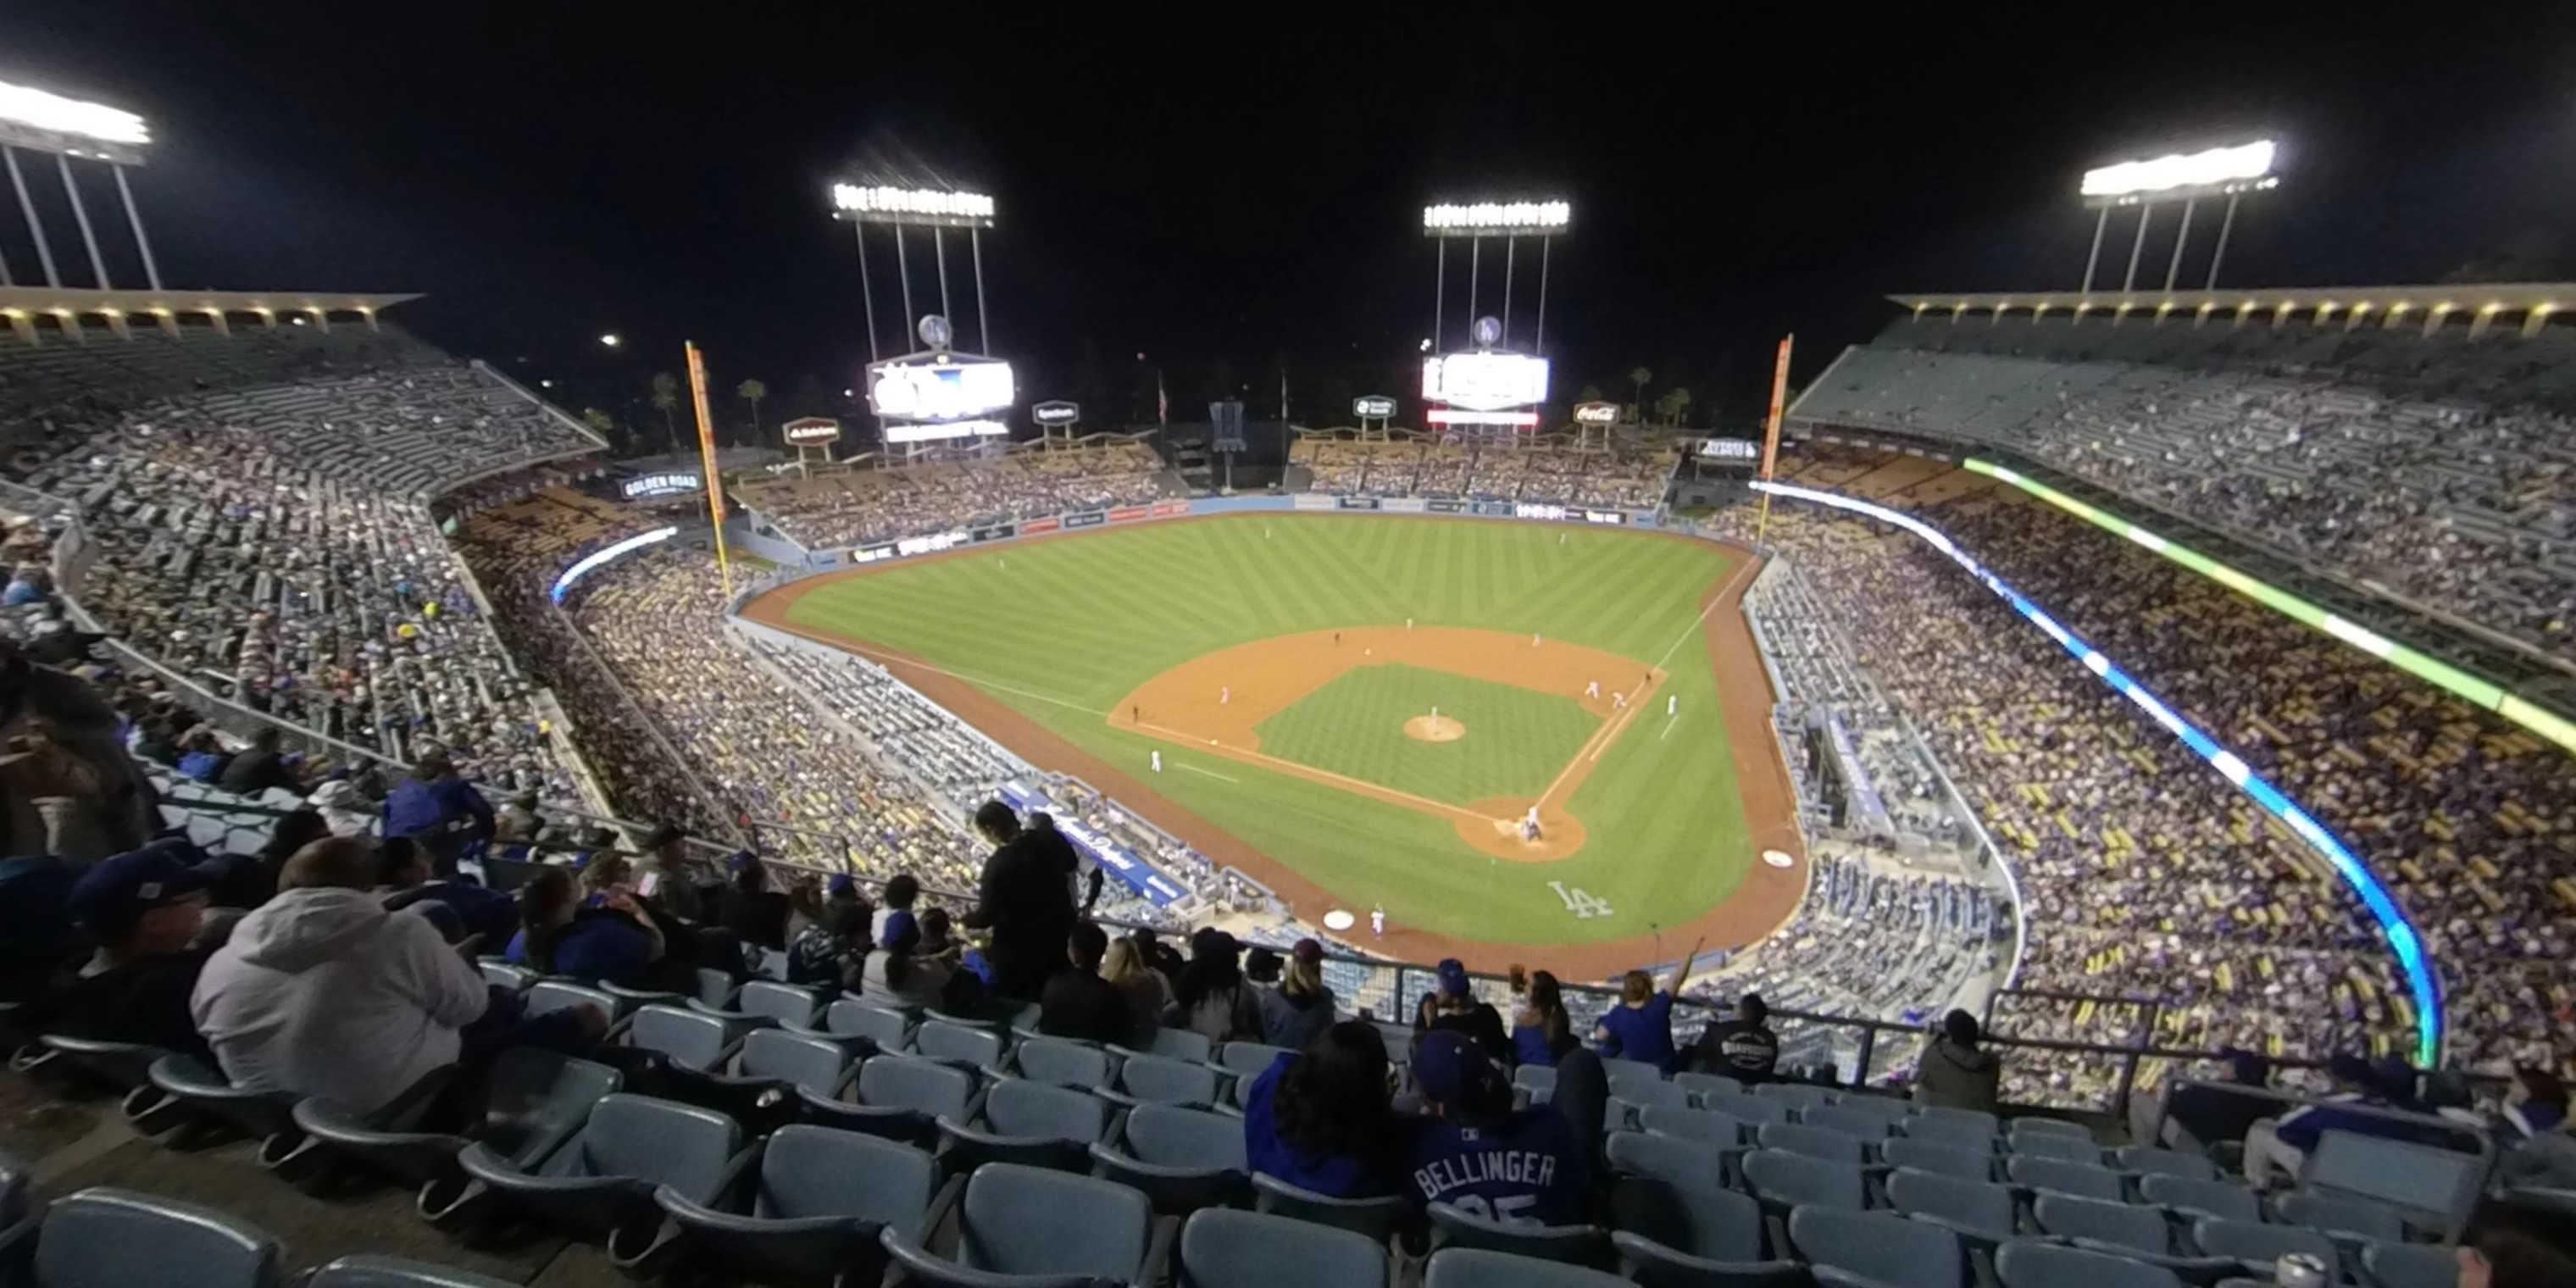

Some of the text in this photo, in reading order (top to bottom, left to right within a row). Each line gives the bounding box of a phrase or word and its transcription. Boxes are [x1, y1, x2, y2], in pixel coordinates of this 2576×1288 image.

[625, 476, 667, 496] GOLDEN
[668, 475, 697, 487] ROAD
[1546, 880, 1613, 918] LA
[1414, 1151, 1556, 1200] BELLINGER
